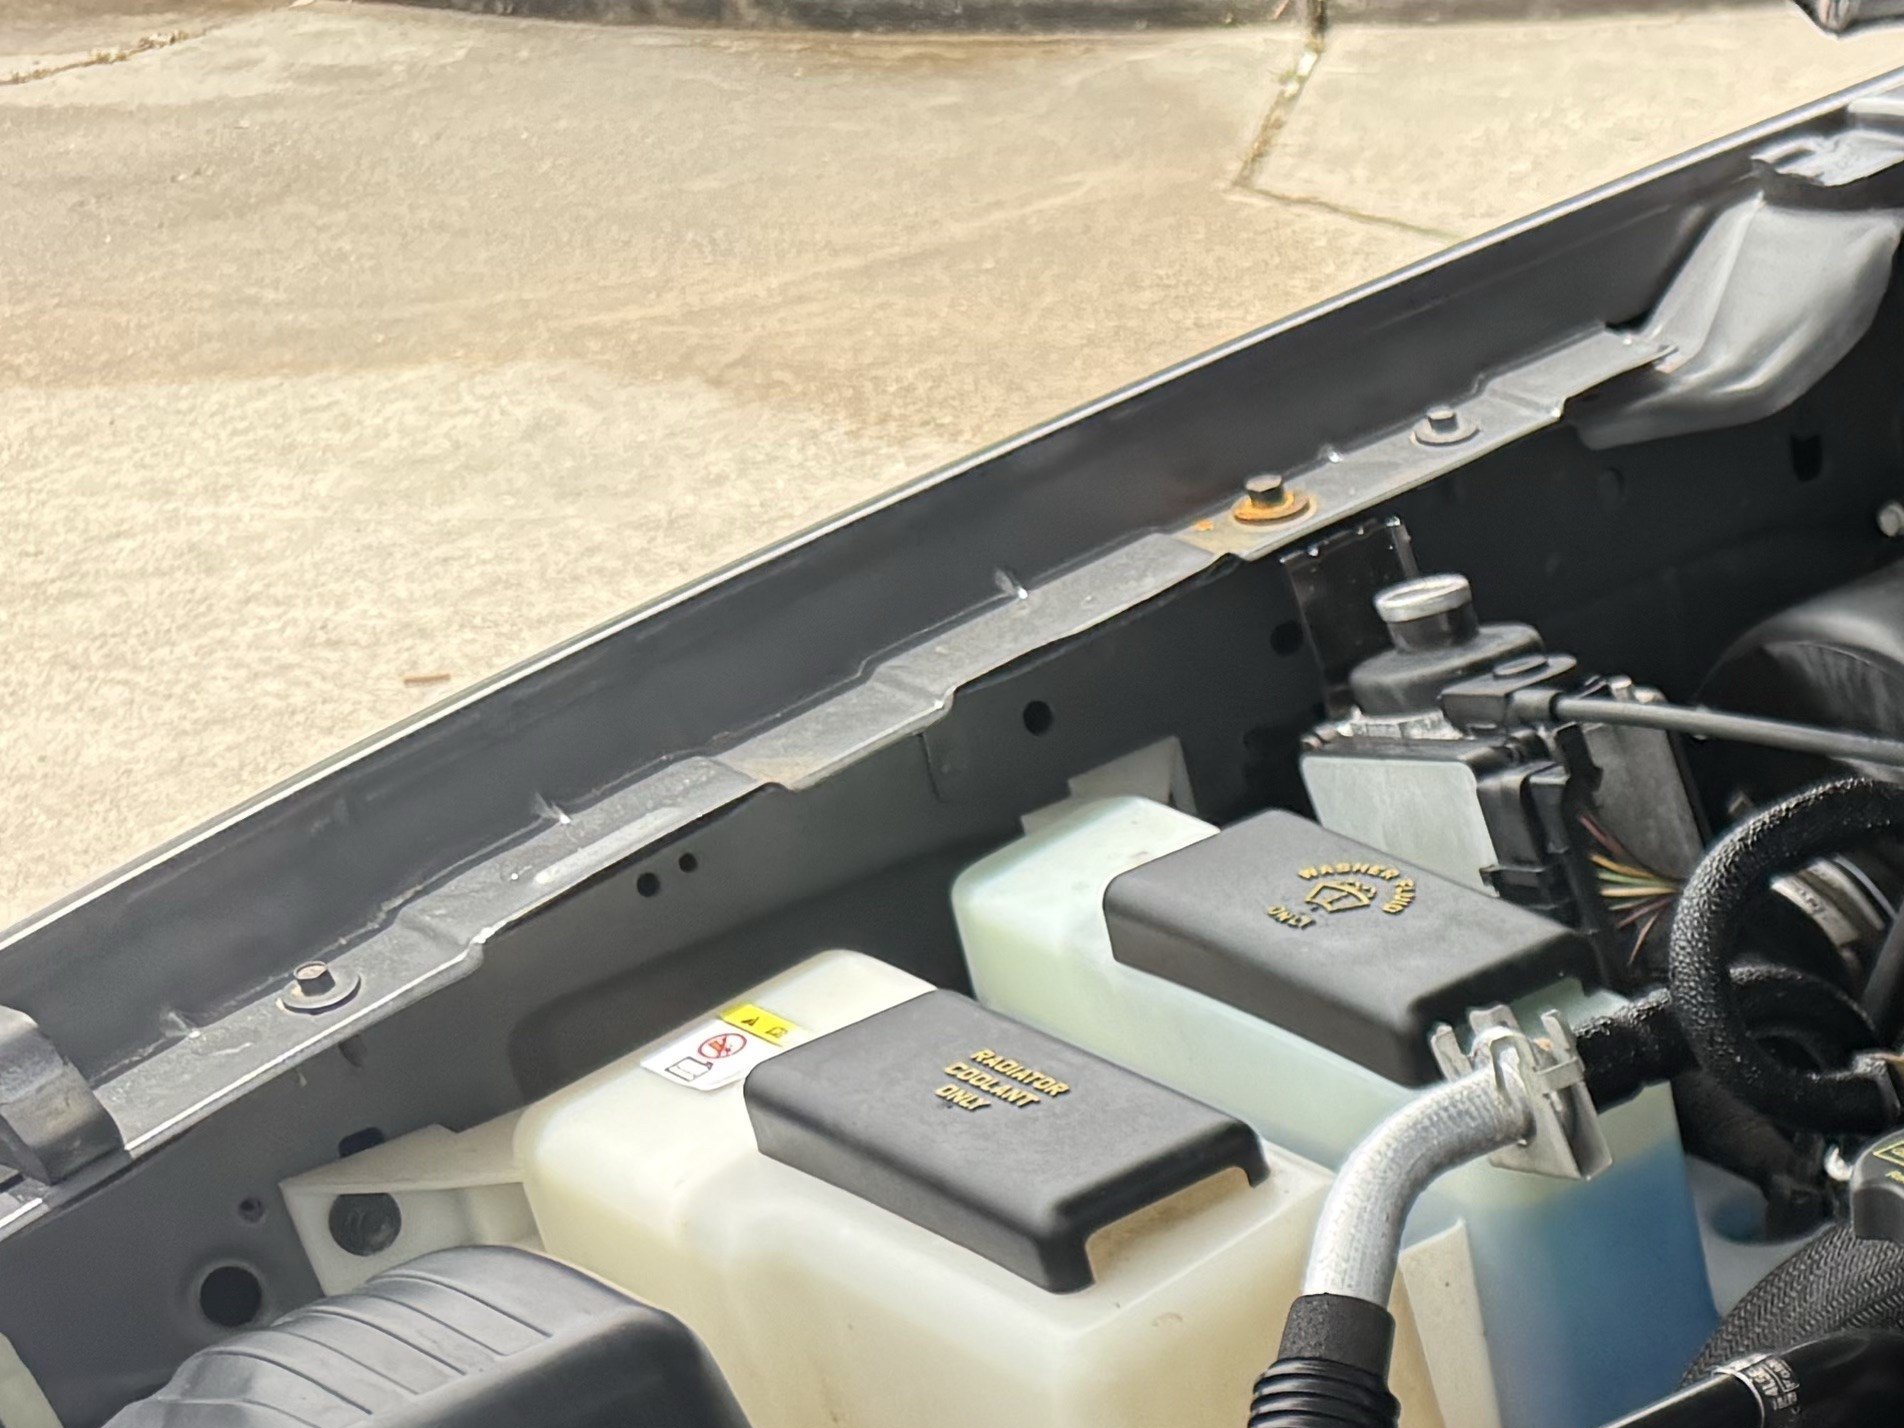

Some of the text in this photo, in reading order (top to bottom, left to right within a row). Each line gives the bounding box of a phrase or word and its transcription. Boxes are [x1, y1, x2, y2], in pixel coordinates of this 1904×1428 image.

[944, 1062, 1042, 1108] COOLANT
[969, 1049, 1070, 1097] RADIATOR
[935, 1085, 991, 1112] ONLY
